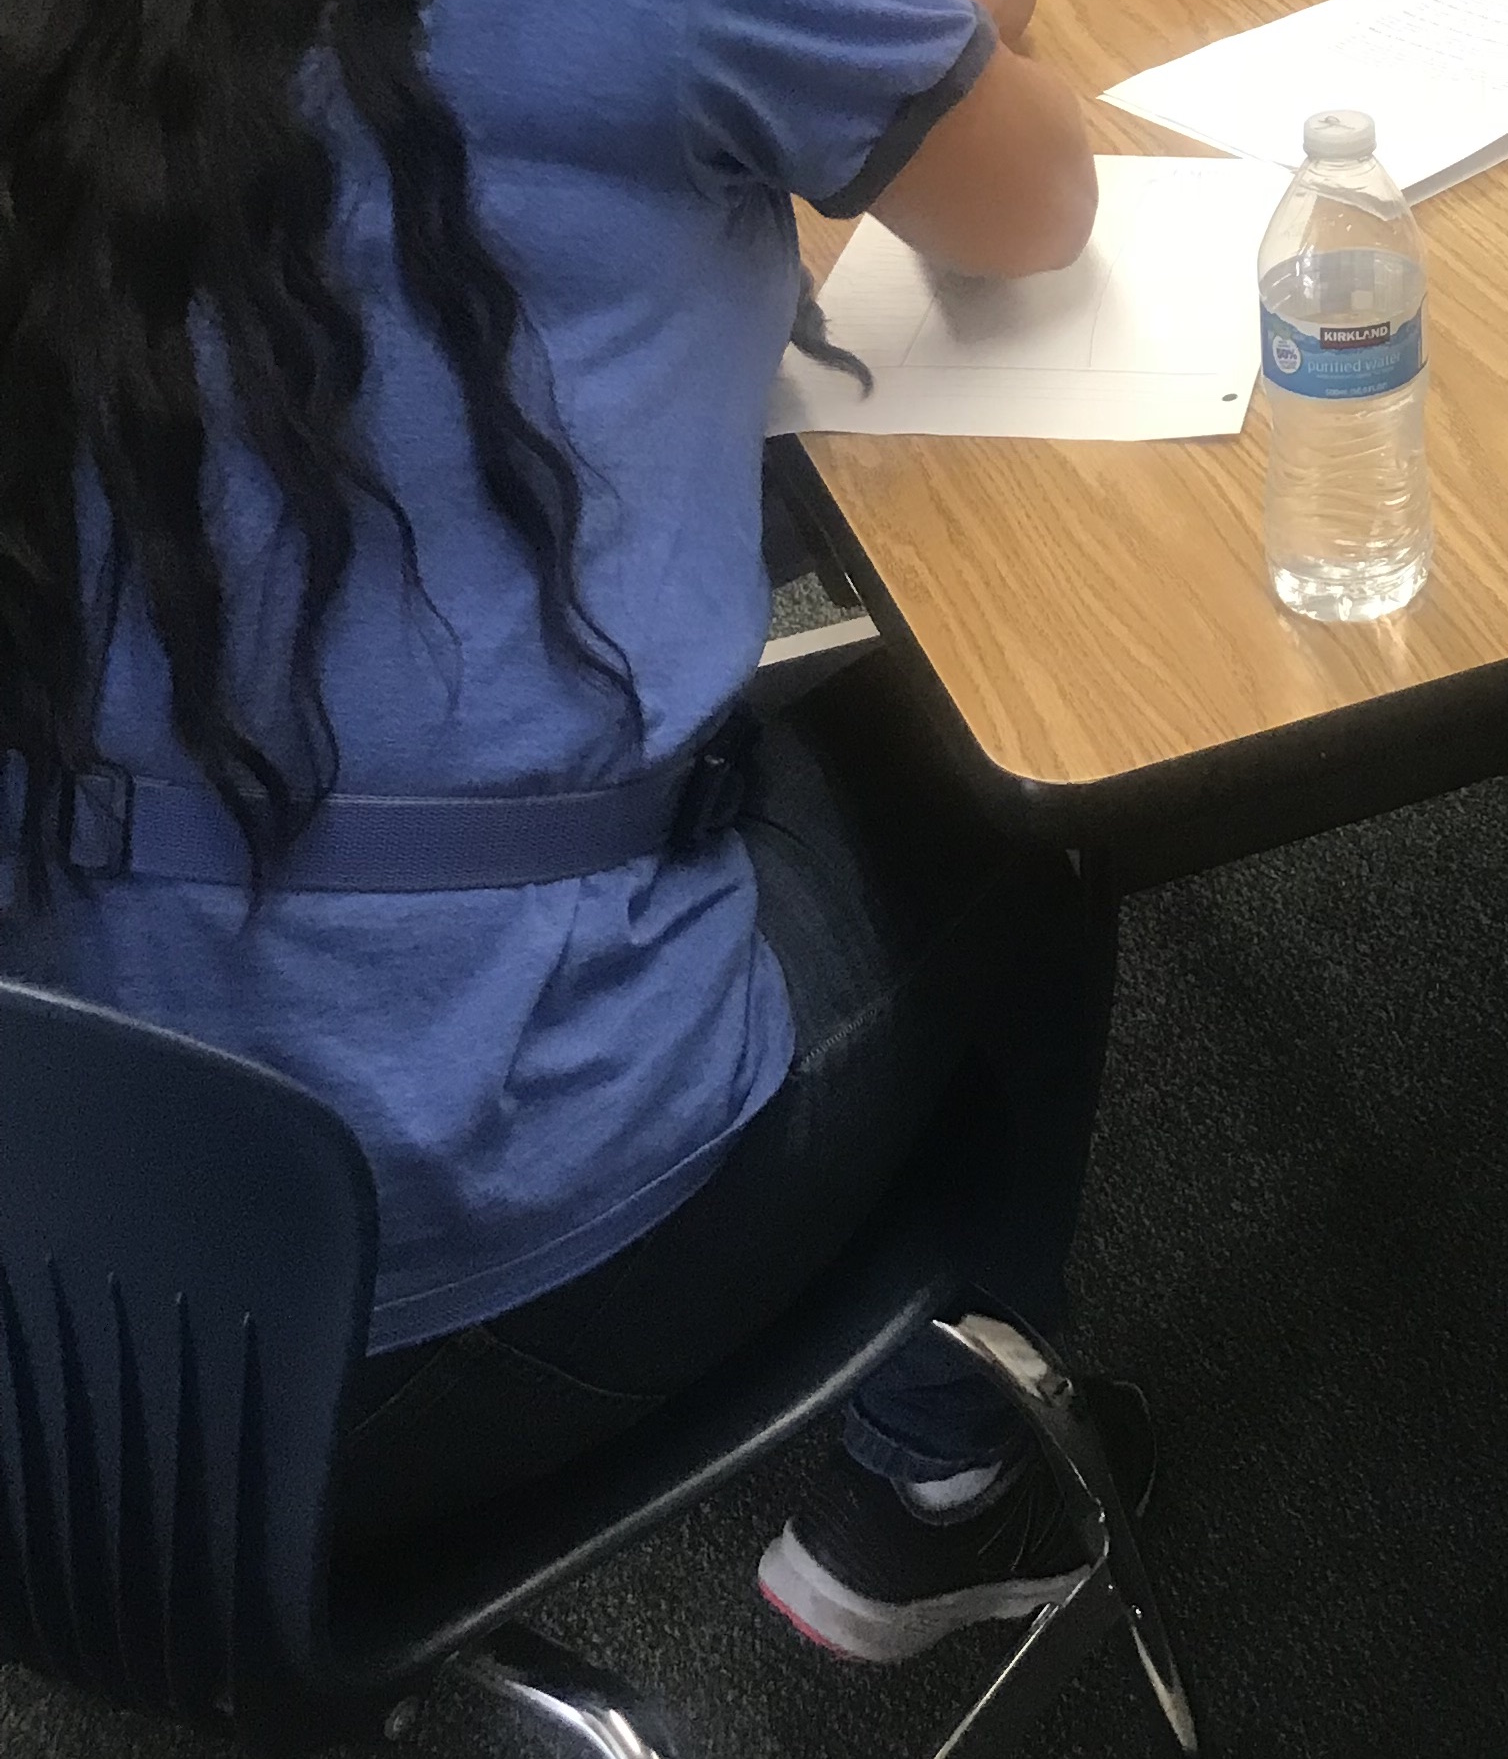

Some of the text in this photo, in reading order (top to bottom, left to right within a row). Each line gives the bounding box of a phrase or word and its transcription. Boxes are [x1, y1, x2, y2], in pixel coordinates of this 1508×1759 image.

[1323, 325, 1389, 343] KIRKLAND
[1307, 359, 1362, 374] purified
[1365, 351, 1402, 370] water
